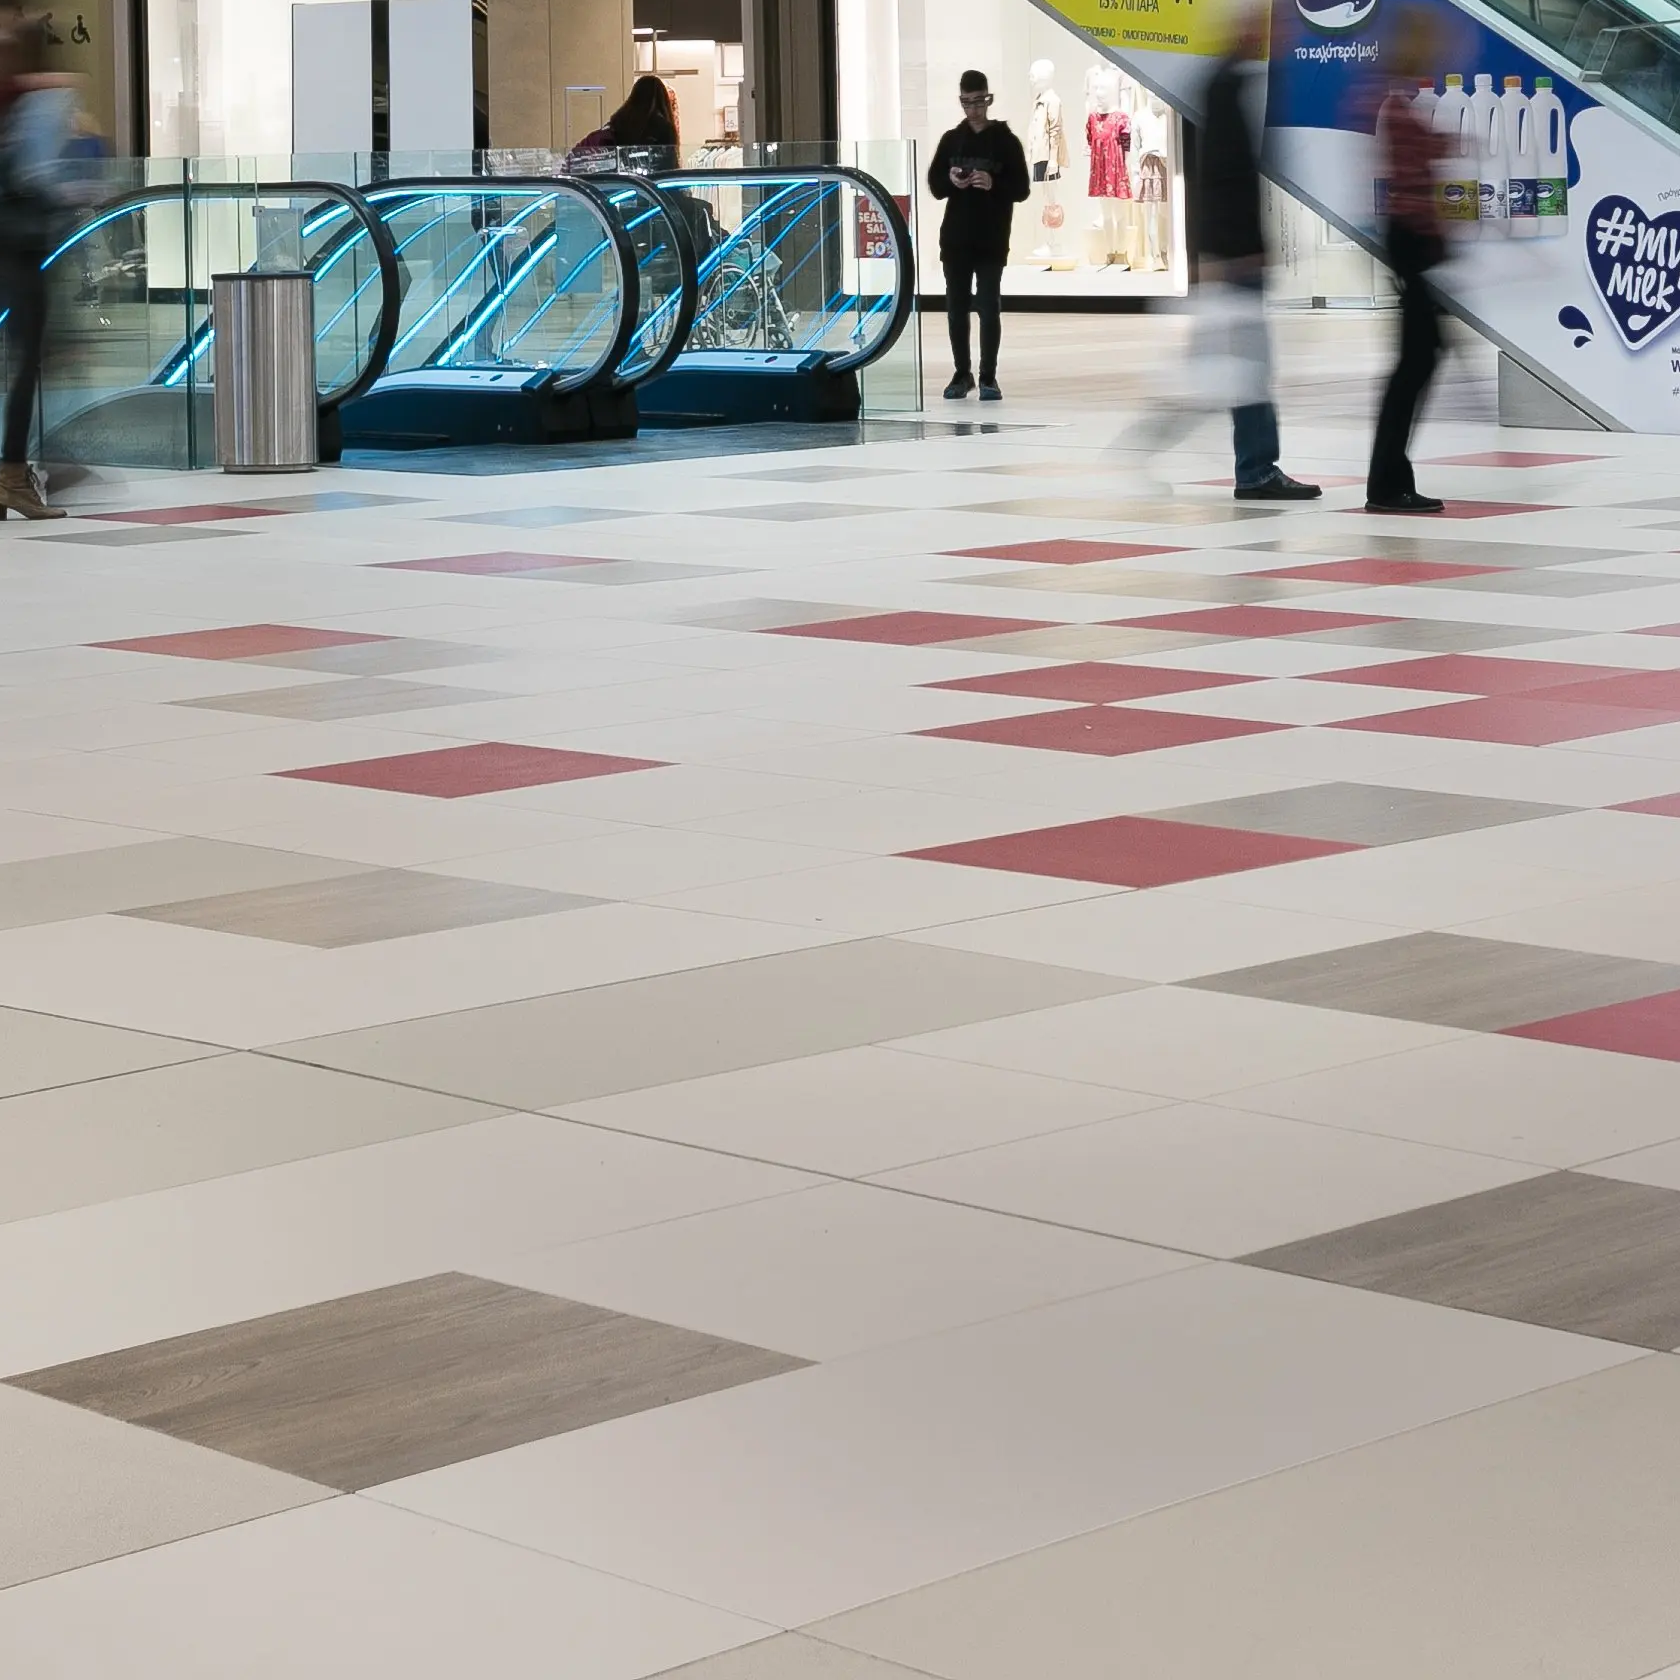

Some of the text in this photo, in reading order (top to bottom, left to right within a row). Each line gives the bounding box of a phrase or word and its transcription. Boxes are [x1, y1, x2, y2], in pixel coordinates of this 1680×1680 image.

[1294, 47, 1308, 60] το
[858, 212, 885, 223] SEAS
[866, 224, 887, 234] SAL
[1606, 262, 1675, 313] Milk
